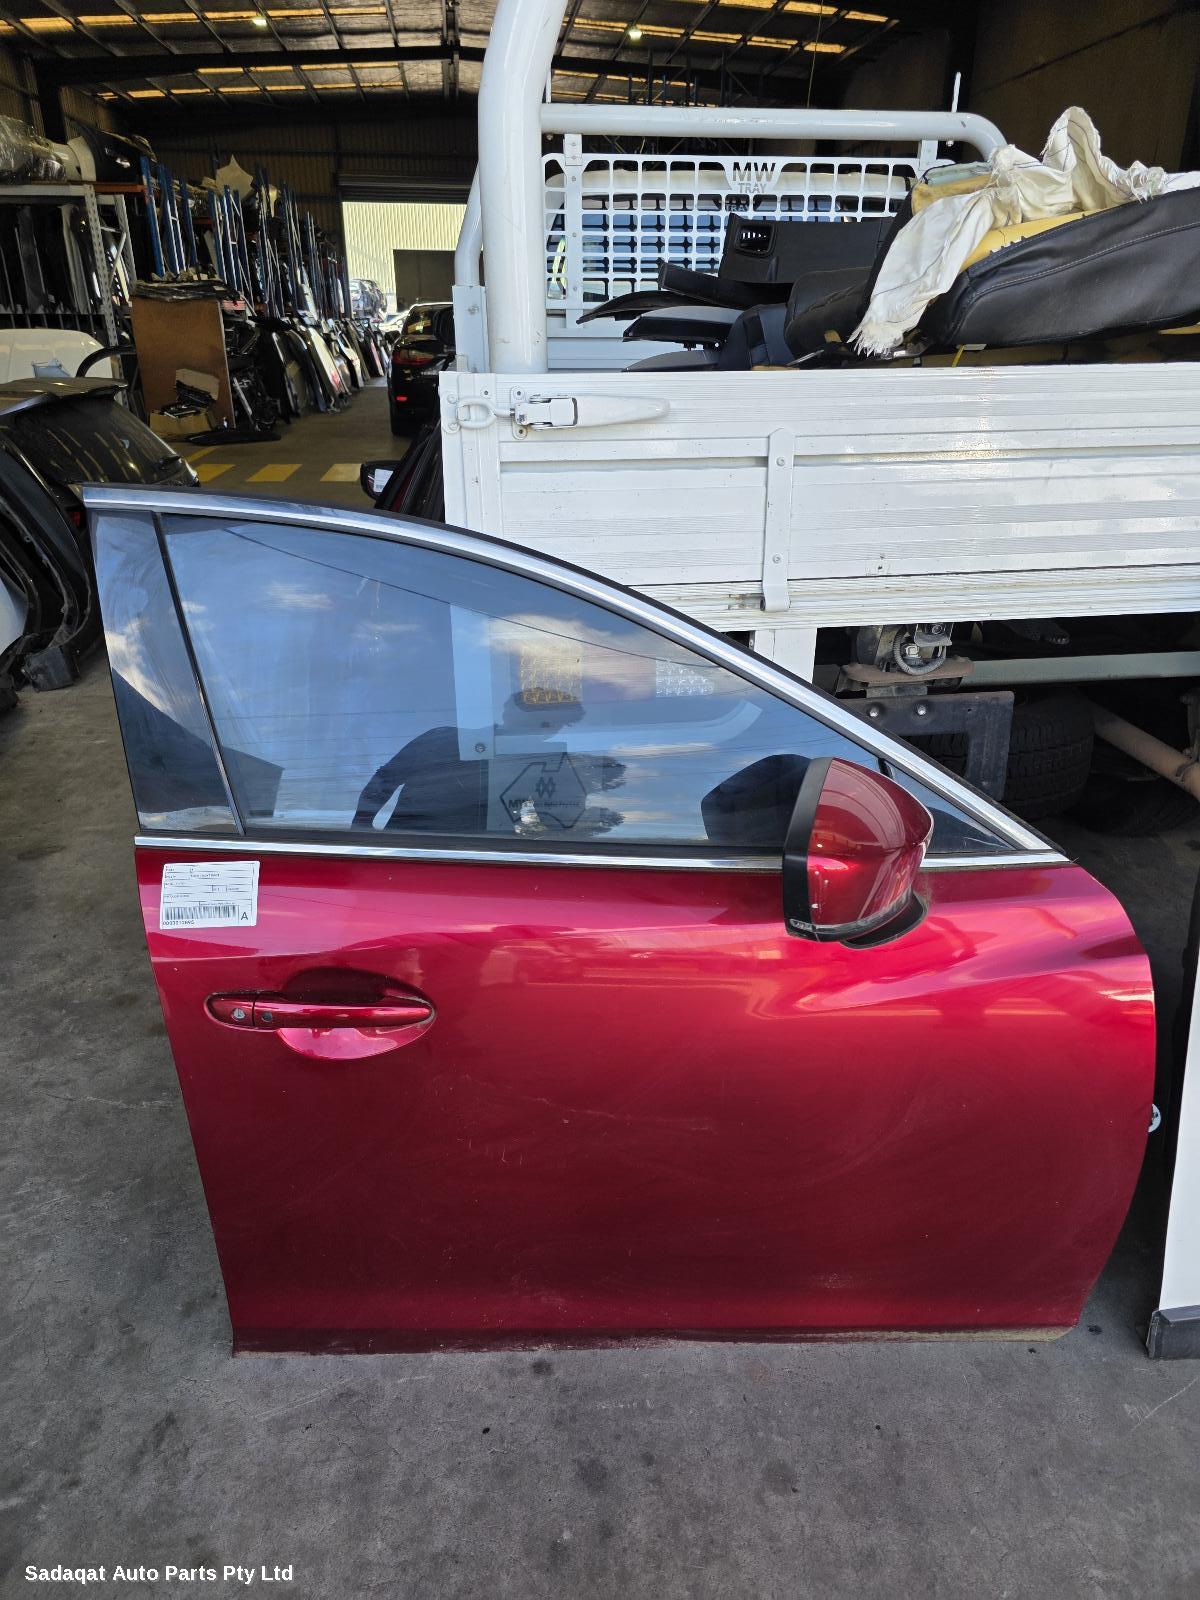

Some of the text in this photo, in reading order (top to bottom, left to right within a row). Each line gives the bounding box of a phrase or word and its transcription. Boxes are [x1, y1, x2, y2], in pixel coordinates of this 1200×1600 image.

[733, 162, 776, 181] MW
[738, 183, 767, 193] TRAY
[241, 912, 248, 920] A
